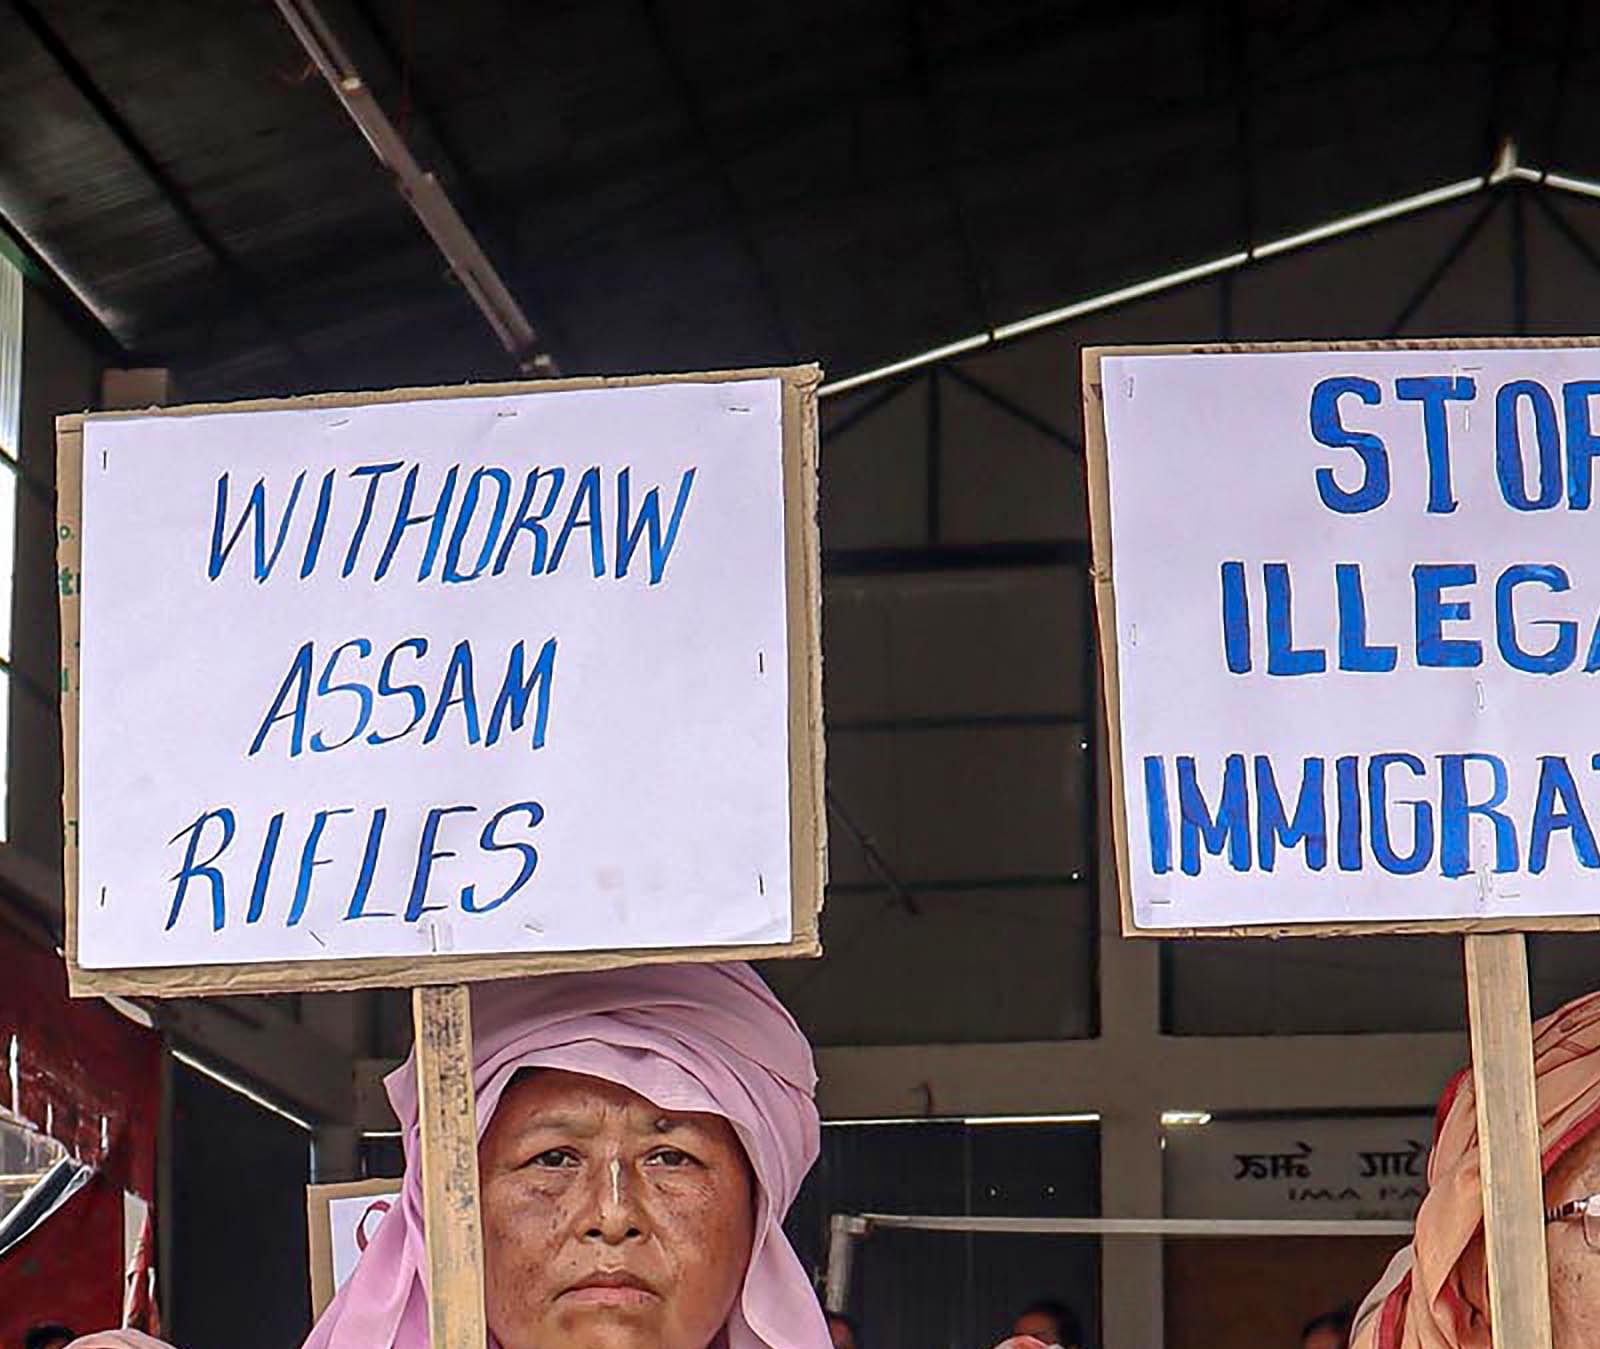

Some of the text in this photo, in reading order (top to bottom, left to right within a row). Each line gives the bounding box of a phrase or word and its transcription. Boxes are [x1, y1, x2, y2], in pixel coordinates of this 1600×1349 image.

[208, 462, 696, 586] WITHDRAW
[248, 638, 558, 758] ASSAM
[165, 801, 545, 932] RIFLES
[1287, 1188, 1361, 1201] IMA
